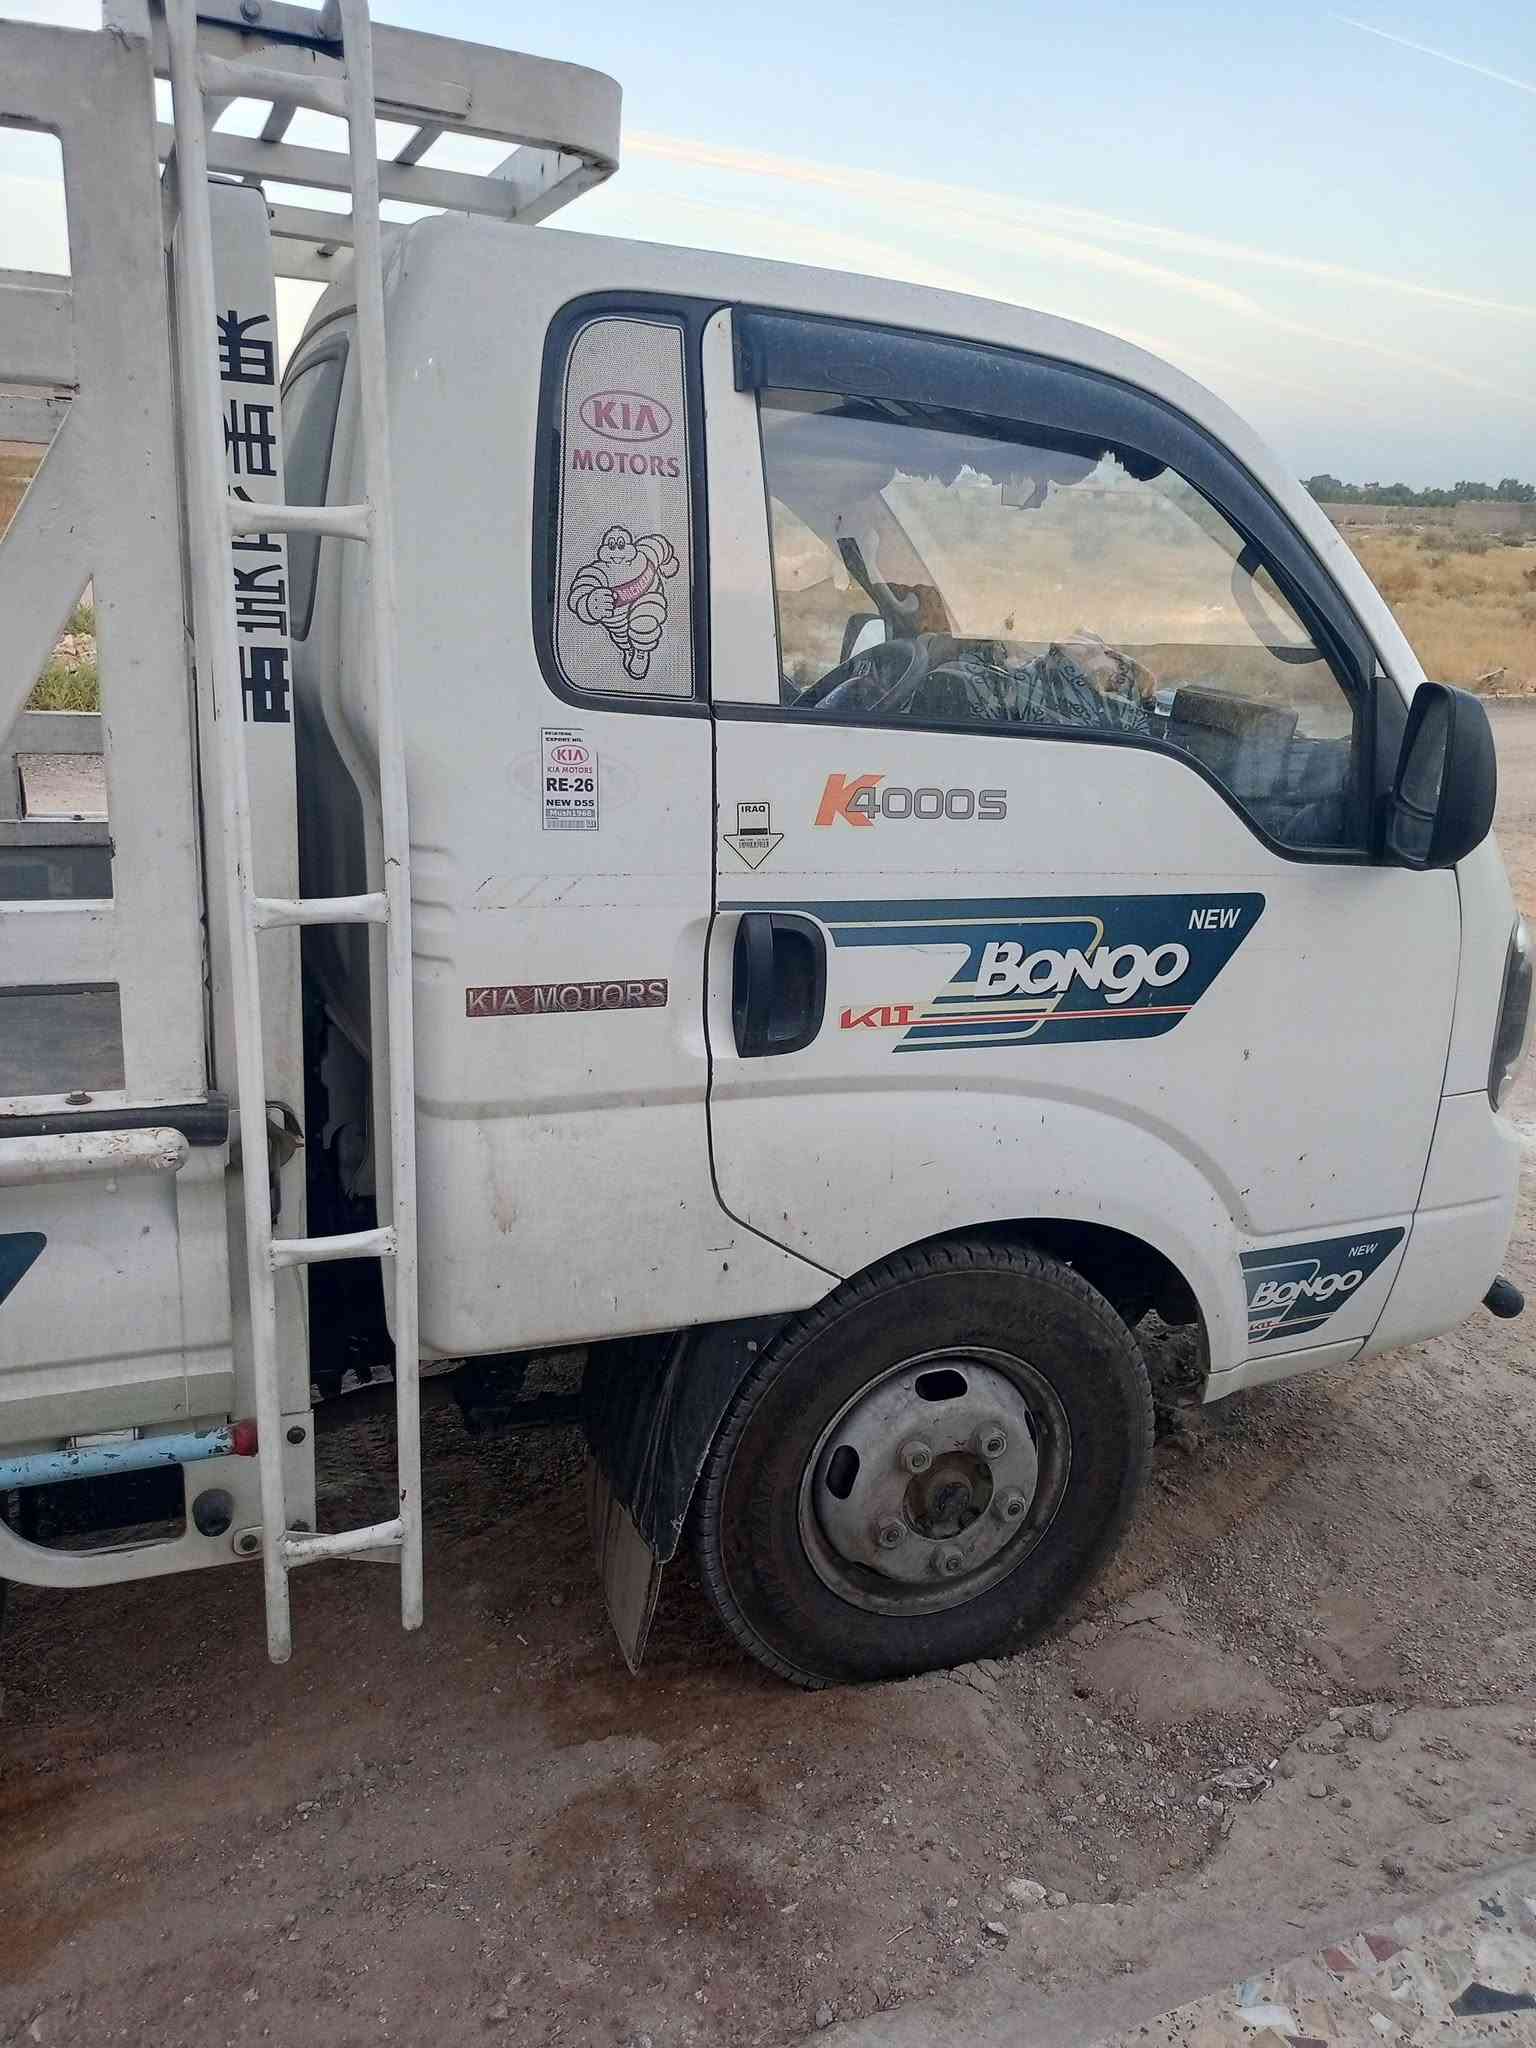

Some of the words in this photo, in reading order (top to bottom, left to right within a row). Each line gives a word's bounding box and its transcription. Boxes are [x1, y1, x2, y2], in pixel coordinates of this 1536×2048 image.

[592, 400, 659, 433] KIA
[572, 449, 680, 478] MOTORS
[556, 749, 584, 761] KIA
[547, 766, 560, 774] KIA
[561, 766, 593, 774] MOTORS
[546, 777, 594, 793] RE-26
[546, 799, 571, 807] NEW
[1188, 908, 1241, 930] NEW
[469, 988, 520, 1011] KIA
[534, 982, 666, 1011] MOTORS
[1348, 1242, 1379, 1257] NEW
